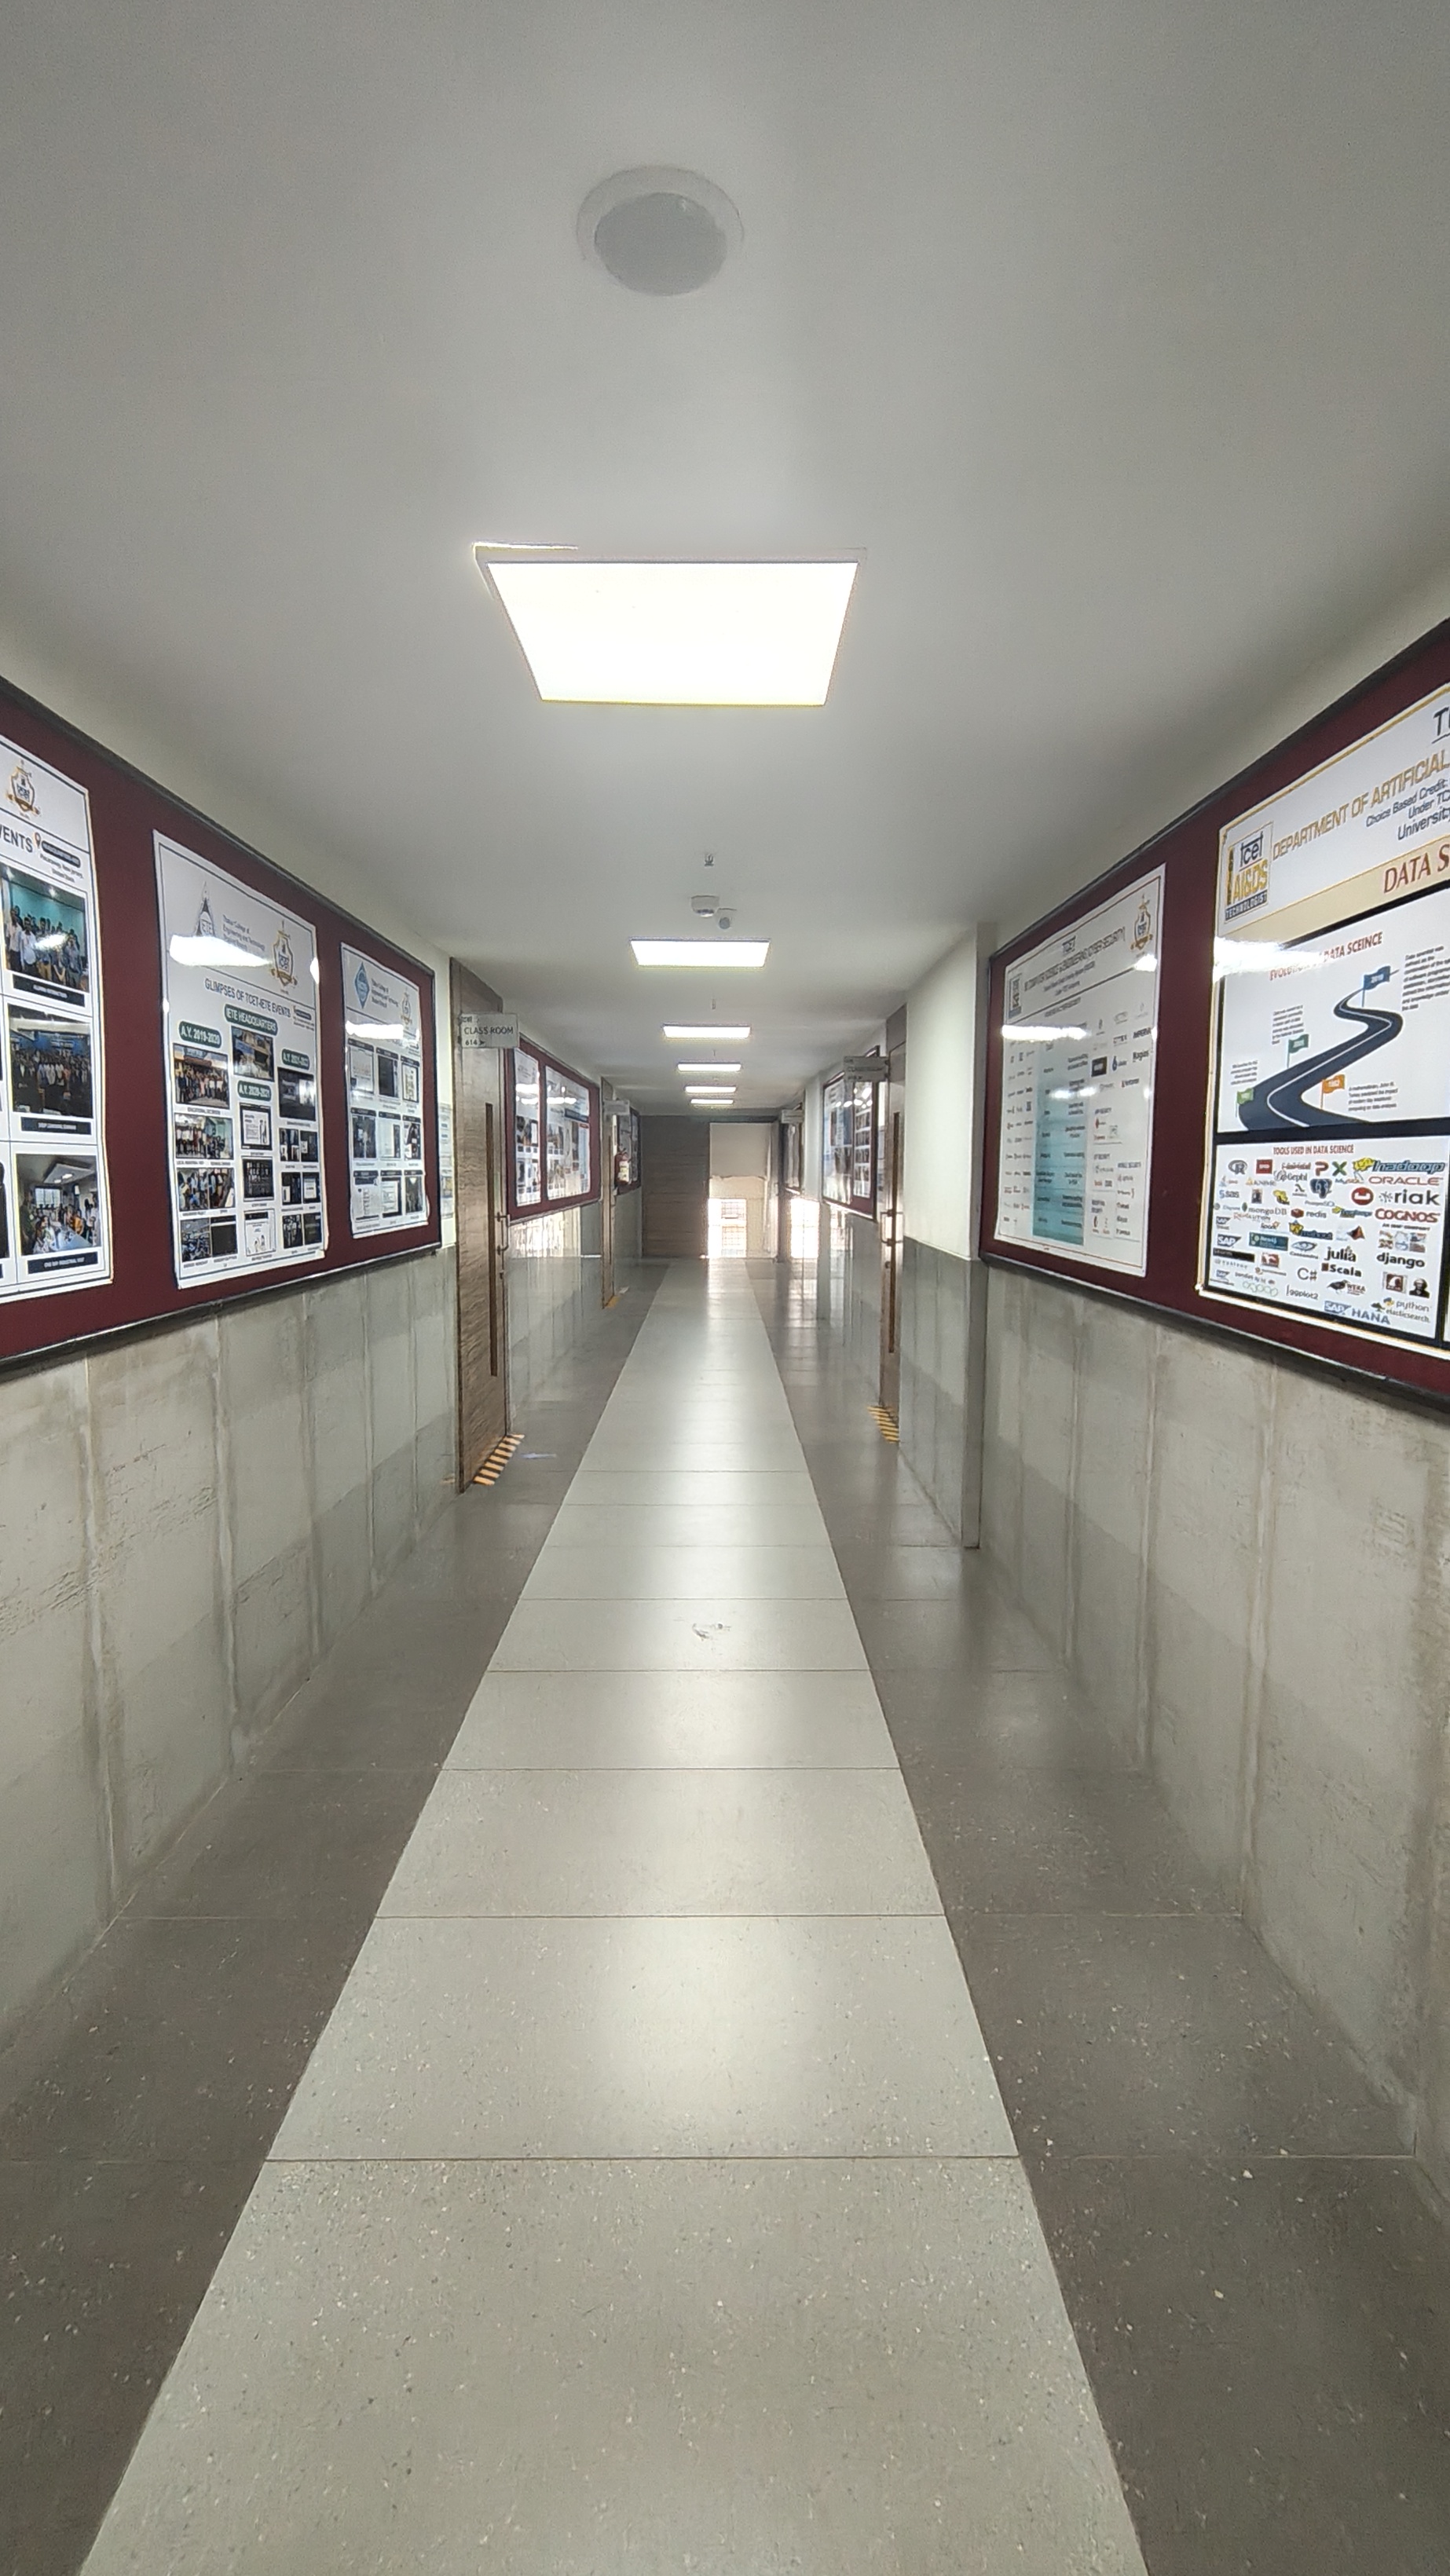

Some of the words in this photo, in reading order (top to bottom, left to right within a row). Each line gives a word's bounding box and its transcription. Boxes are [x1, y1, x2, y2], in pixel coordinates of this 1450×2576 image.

[1272, 803, 1349, 860] DEPARTMENT
[1351, 792, 1369, 818] OF
[1370, 750, 1450, 808] ARTIFICIAL
[1366, 808, 1390, 827] Choice
[1393, 792, 1417, 814] Based
[1408, 800, 1435, 819] Under
[1383, 852, 1431, 894] DATA
[204, 979, 236, 999] GLIMPSES
[236, 989, 245, 1001] OF
[271, 1001, 291, 1018] EVENTS
[490, 1026, 514, 1034] ROOM
[1291, 1146, 1304, 1154] USED
[1313, 1145, 1328, 1154] DATA
[1329, 1144, 1353, 1153] SCIENCE
[1372, 1159, 1446, 1174] hadoop
[1368, 1176, 1441, 1186] ORACLE
[1394, 1188, 1441, 1206] riak
[1306, 1210, 1327, 1219] redis
[1375, 1208, 1439, 1223] COGNOS
[1217, 1235, 1236, 1247] SAP
[1324, 1246, 1357, 1262] julia
[1376, 1252, 1426, 1269] django
[1297, 1268, 1317, 1281] C#
[1329, 1264, 1362, 1277] Scala
[1325, 1301, 1344, 1314] SAP
[1351, 1308, 1391, 1325] HANA
[1396, 1300, 1430, 1312] python
